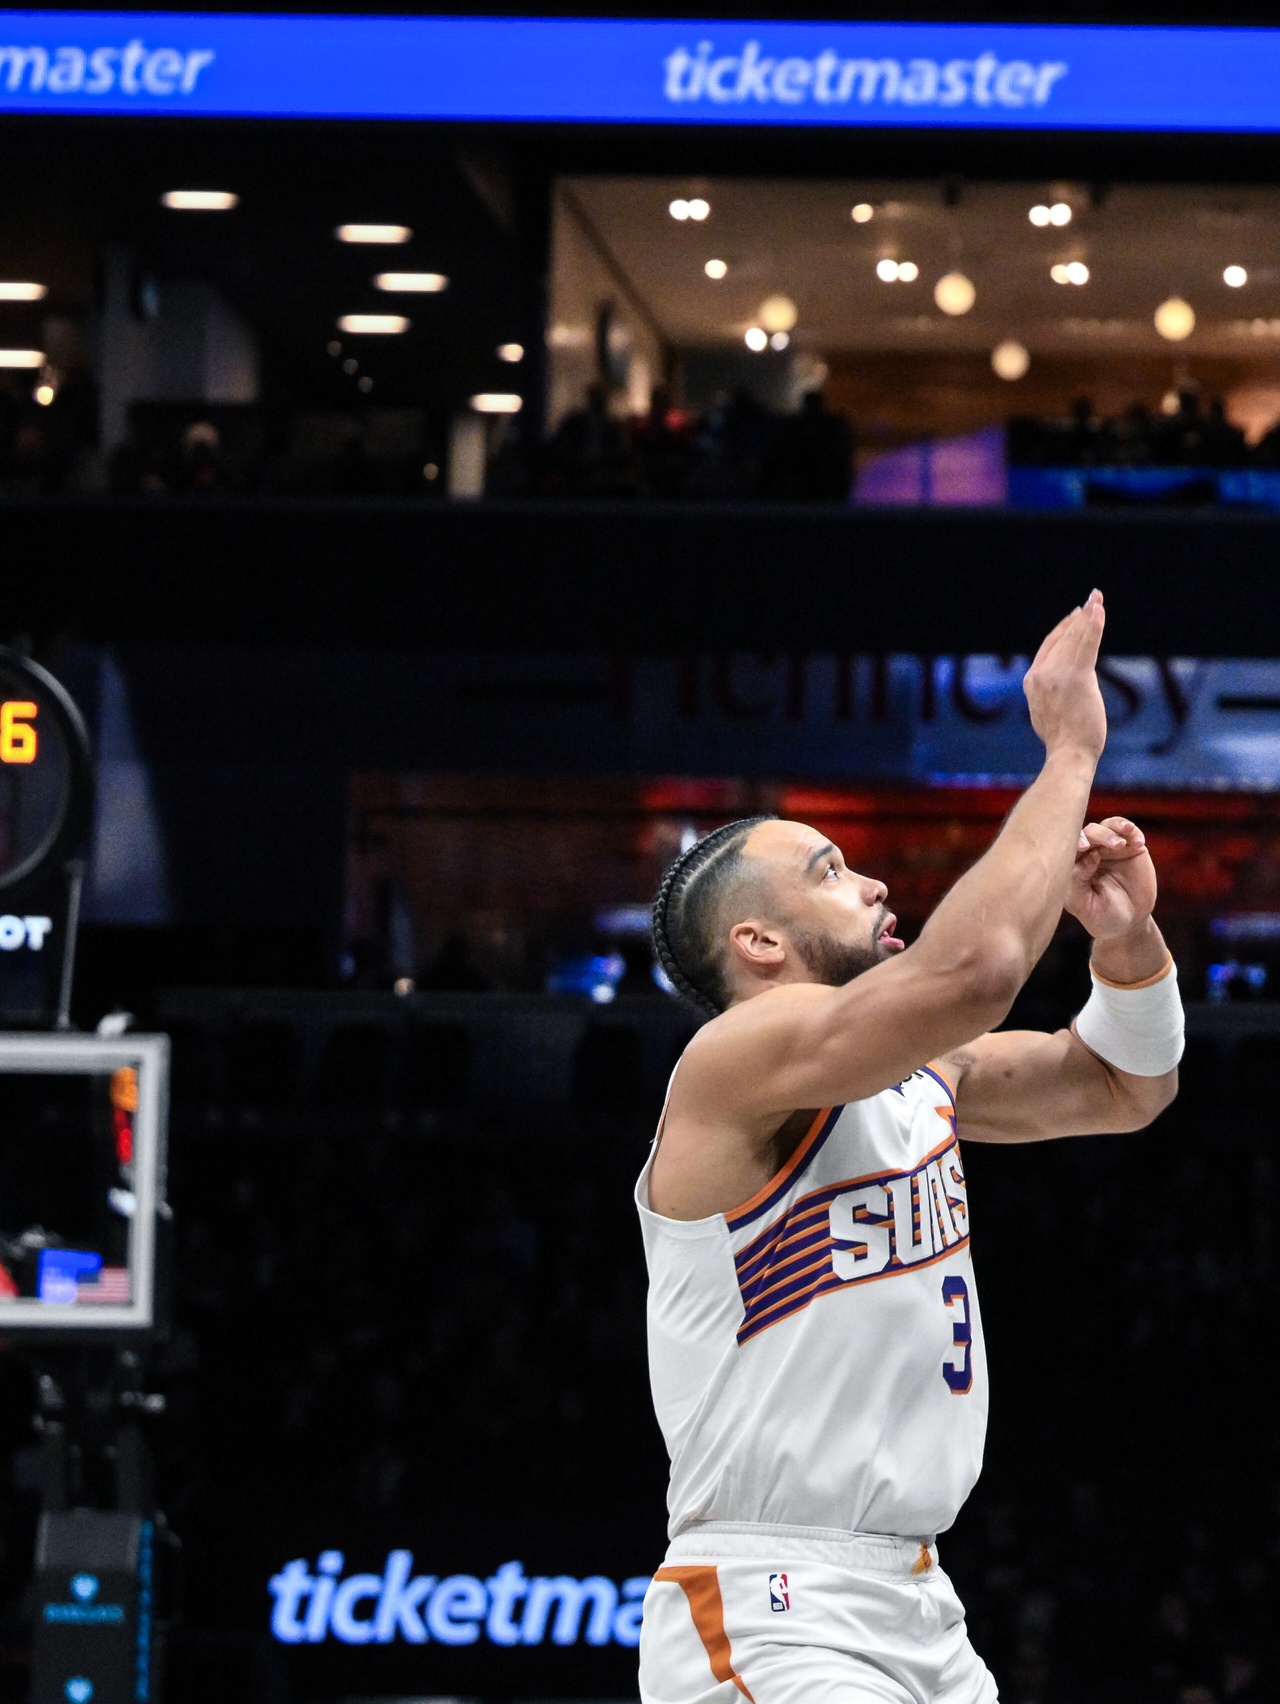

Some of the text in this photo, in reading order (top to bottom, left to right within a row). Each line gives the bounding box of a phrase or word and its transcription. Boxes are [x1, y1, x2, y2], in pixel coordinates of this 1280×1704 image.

[664, 41, 1068, 107] ticketmaster
[829, 1150, 970, 1281] SUNS
[941, 1275, 973, 1395] 3
